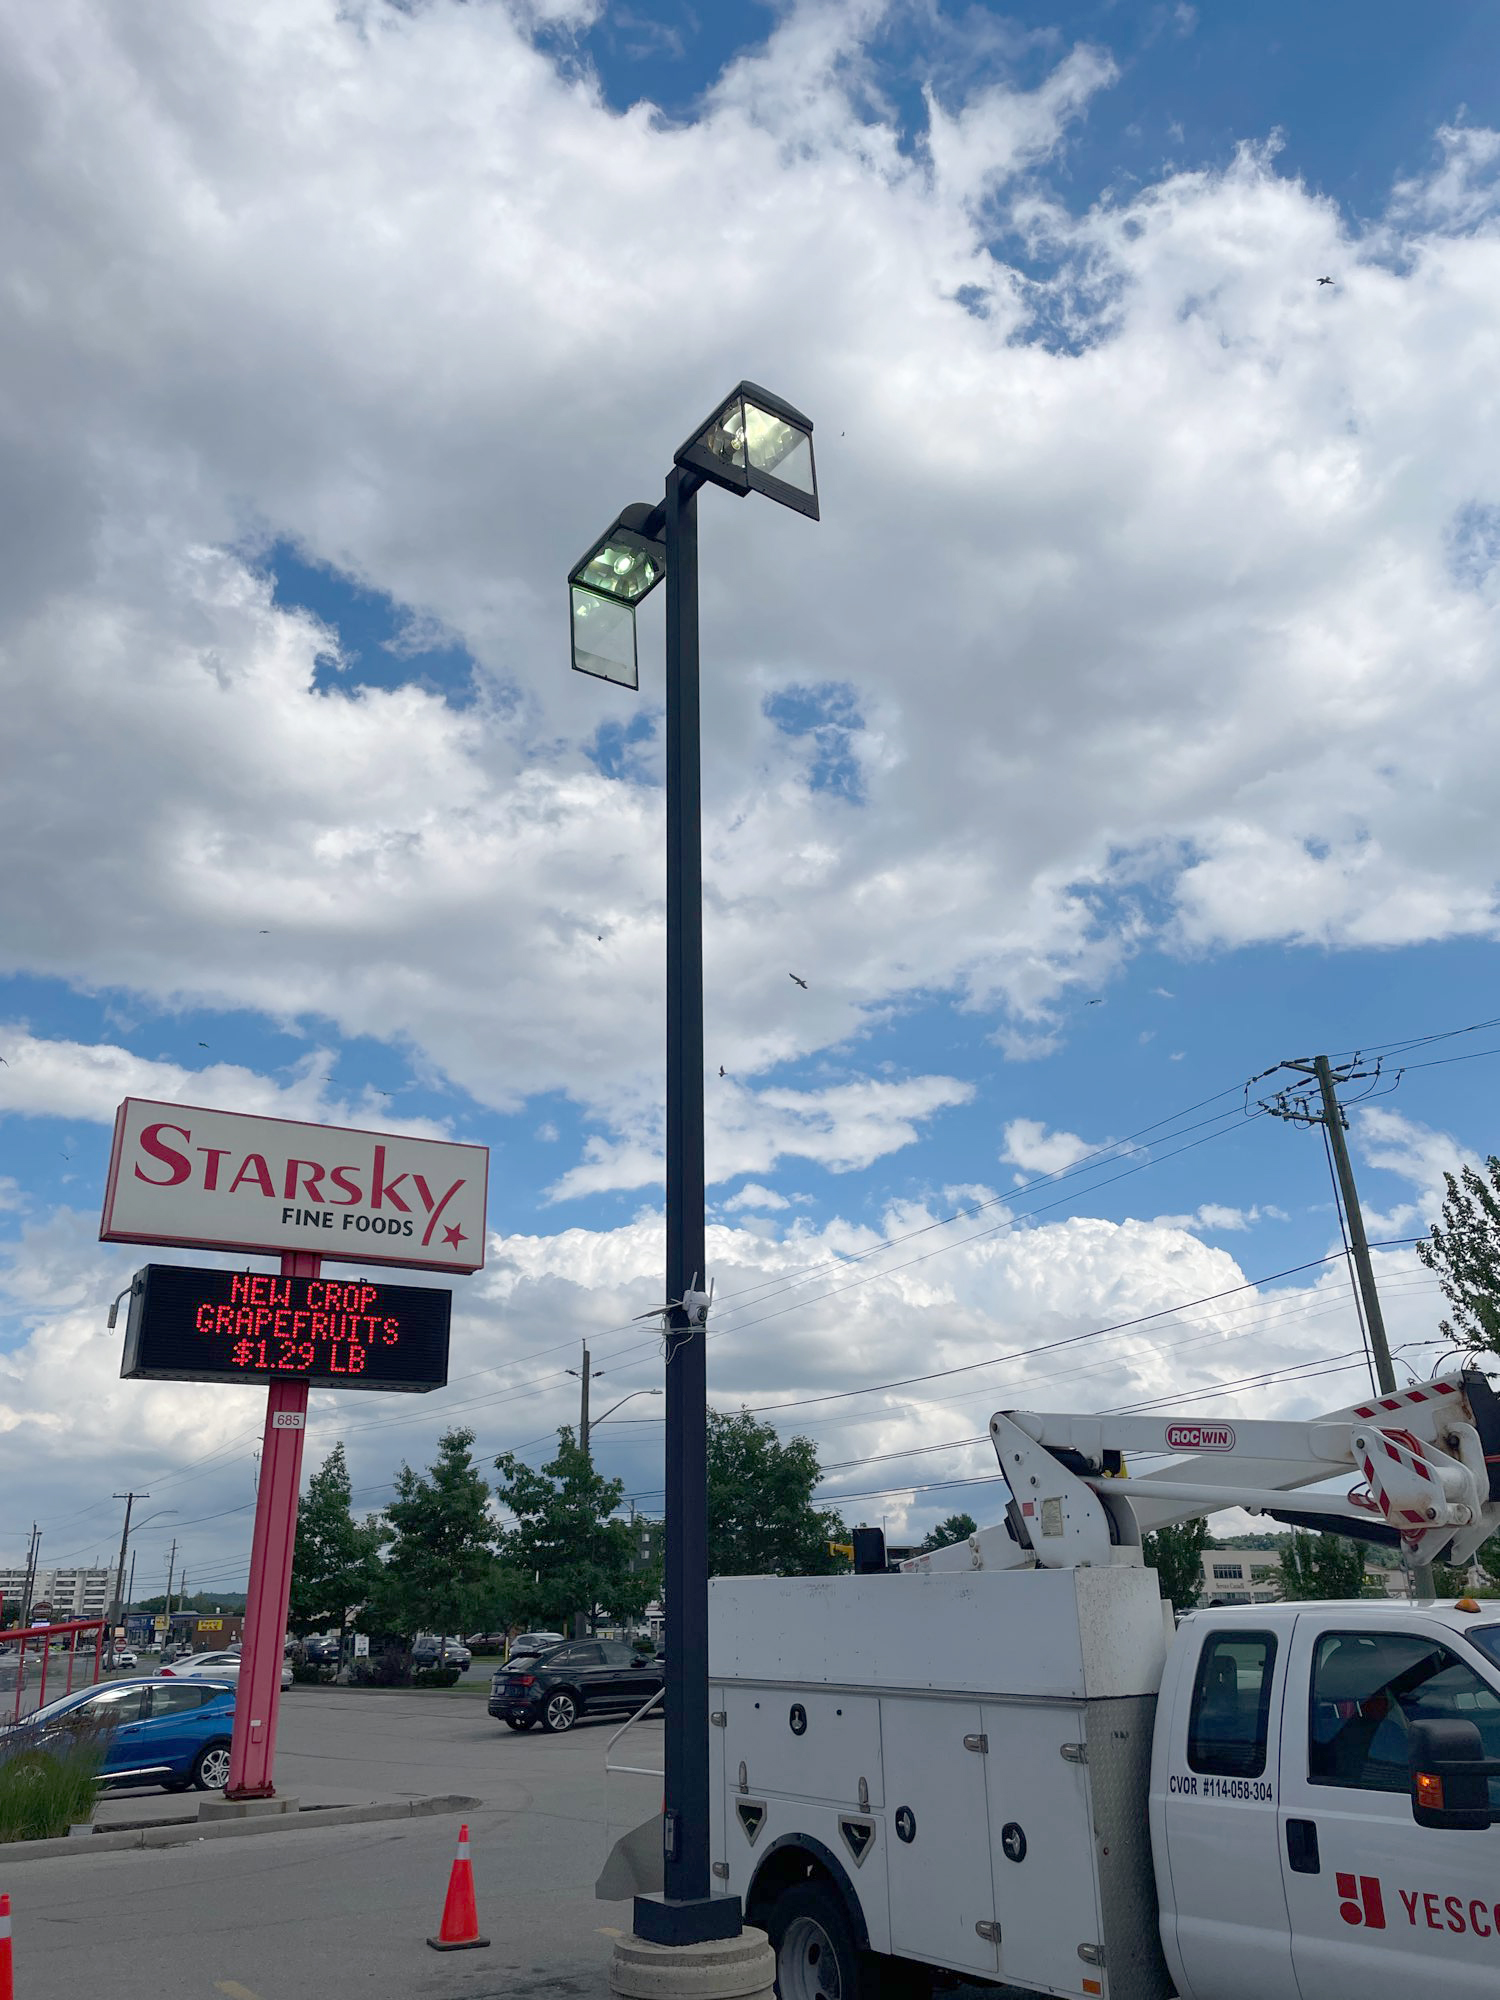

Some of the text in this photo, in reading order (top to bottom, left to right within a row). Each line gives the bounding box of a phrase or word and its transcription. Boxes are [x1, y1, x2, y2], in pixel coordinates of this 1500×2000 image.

[281, 1207, 413, 1236] FINE FOODS
[231, 1275, 377, 1313] NEW CROP
[196, 1303, 399, 1345] GRAPEFRUITS
[231, 1338, 366, 1373] $1.29 LB
[277, 1414, 300, 1426] 685
[1169, 1775, 1273, 1801] CVOR #114-058-304
